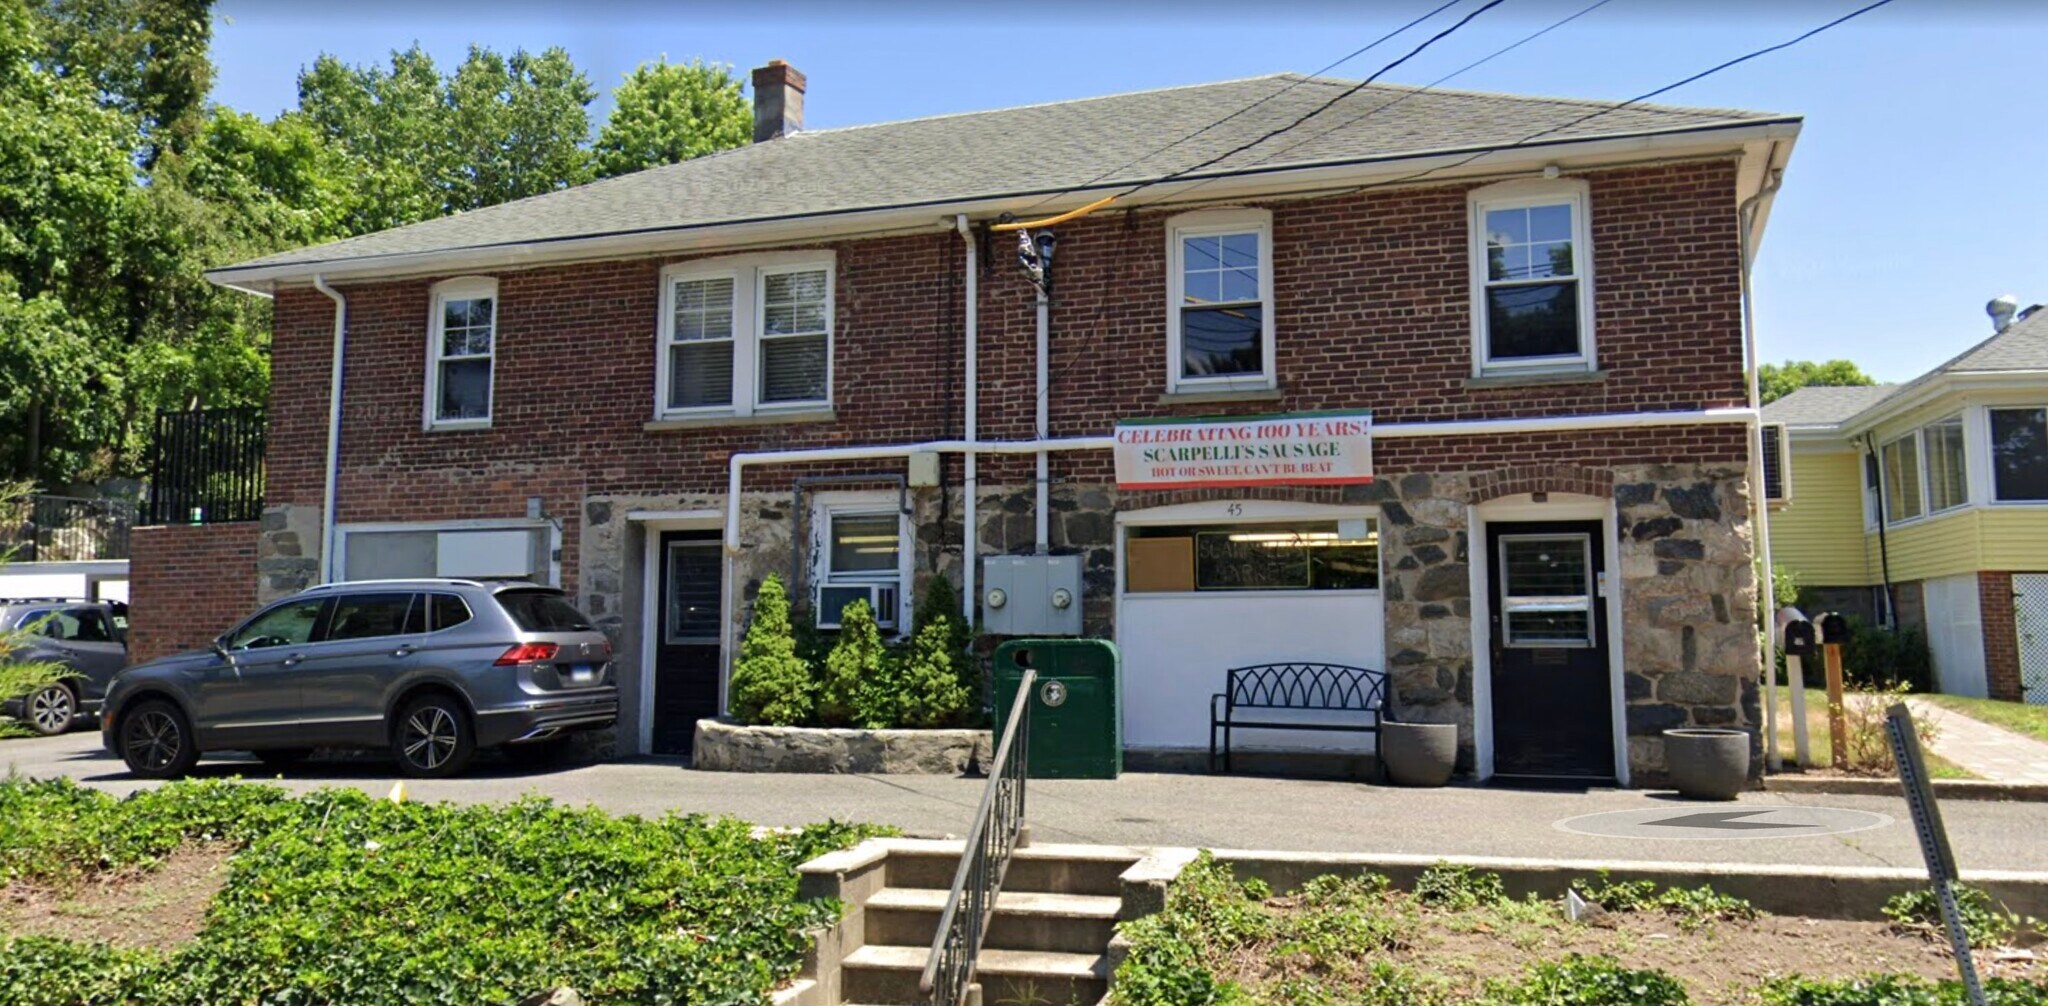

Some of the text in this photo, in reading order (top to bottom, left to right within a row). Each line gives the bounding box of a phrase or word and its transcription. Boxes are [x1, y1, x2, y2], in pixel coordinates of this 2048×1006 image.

[1118, 421, 1368, 444] CELEBRATING 100 YEARS!
[1144, 442, 1341, 462] SCARPELLI'S SAUSAGE
[1152, 467, 1177, 478] HOT
[1180, 467, 1197, 477] OR
[1244, 463, 1280, 475] CAN'T
[1283, 463, 1297, 474] BE
[1301, 462, 1334, 474] BEAT
[1227, 503, 1242, 516] 45
